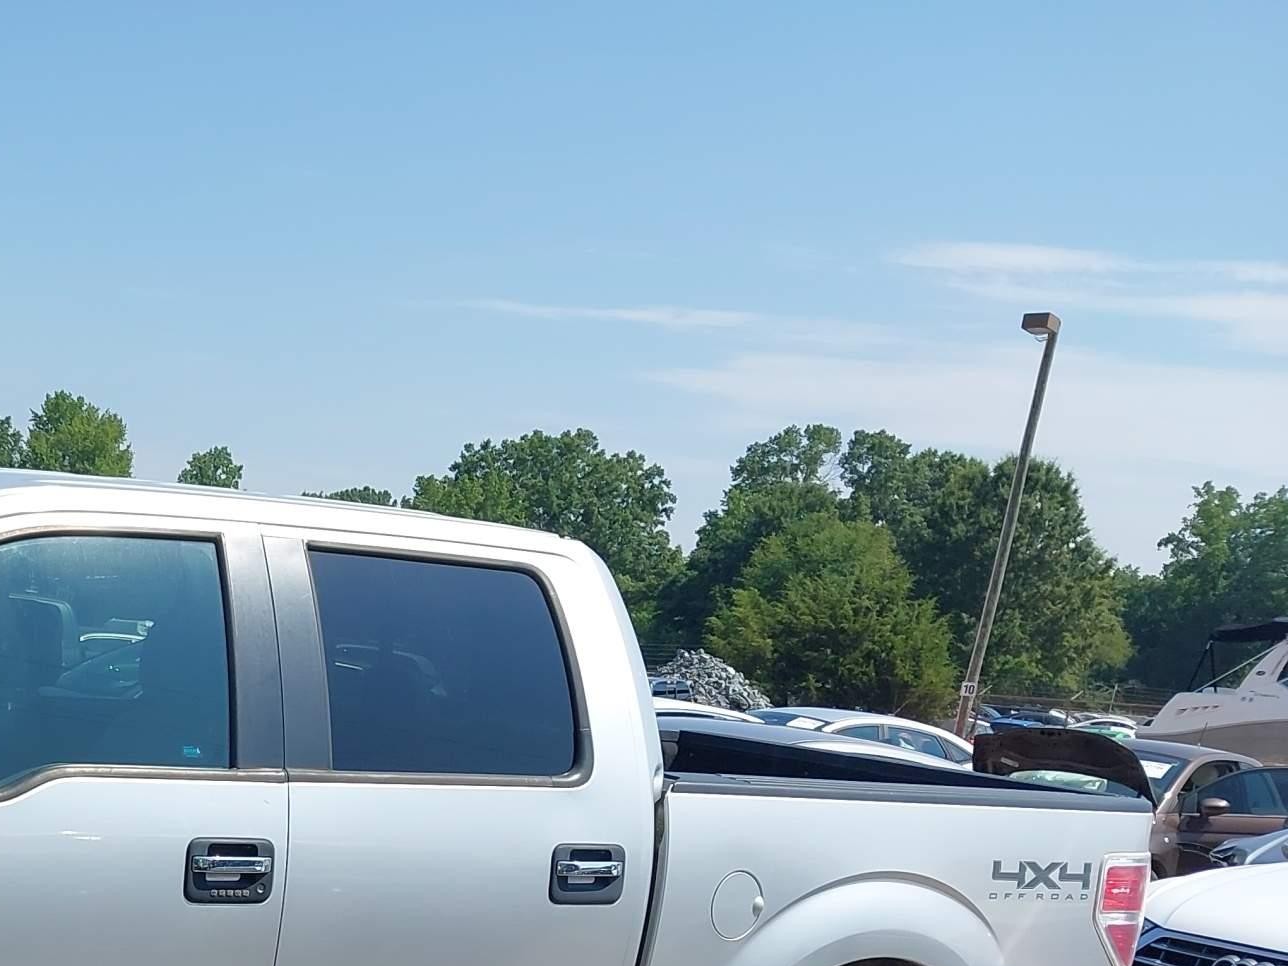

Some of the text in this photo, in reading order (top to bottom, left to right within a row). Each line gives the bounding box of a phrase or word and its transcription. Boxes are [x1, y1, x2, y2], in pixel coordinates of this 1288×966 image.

[964, 685, 975, 694] 10
[992, 860, 1092, 890] 4X4
[988, 892, 1089, 901] OFF ROAD
